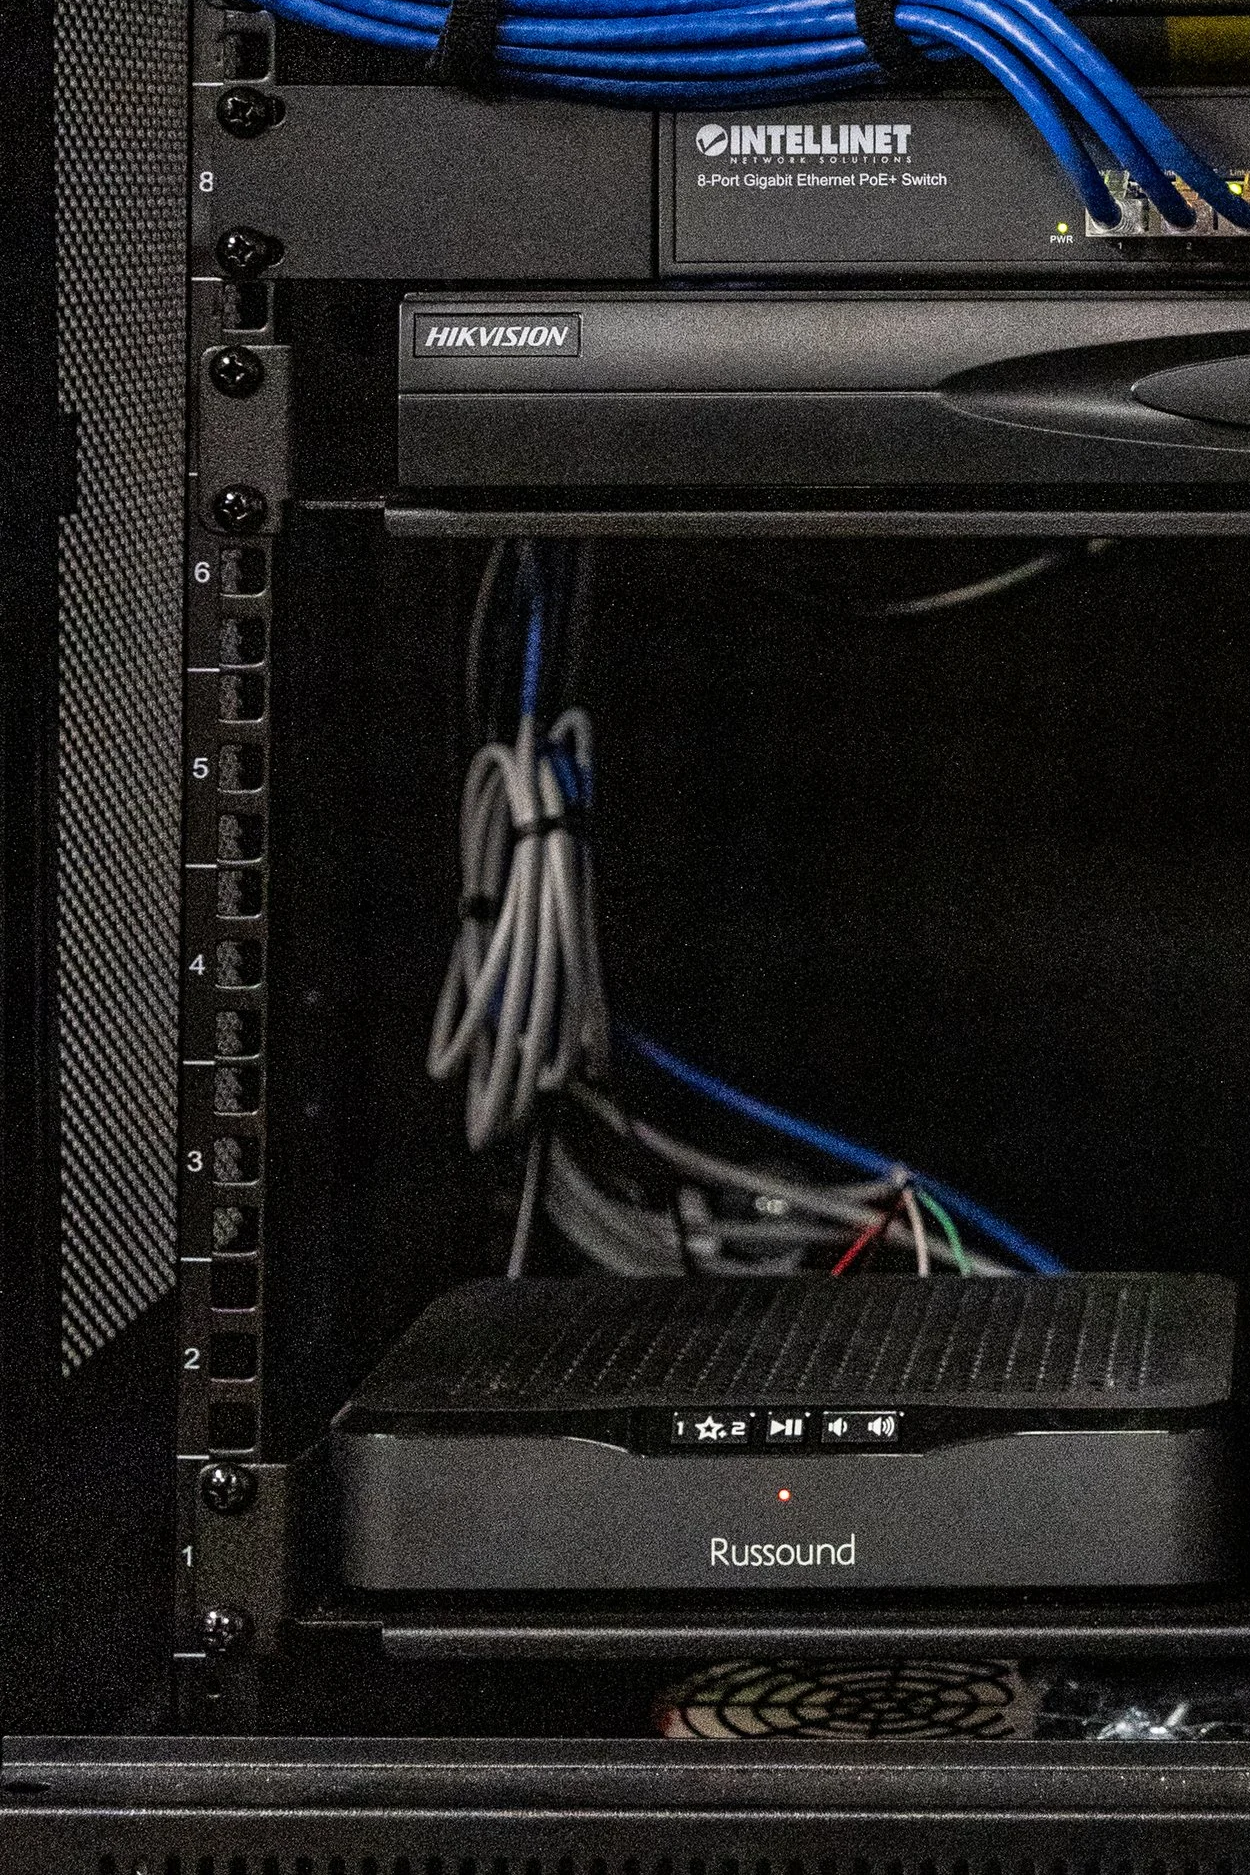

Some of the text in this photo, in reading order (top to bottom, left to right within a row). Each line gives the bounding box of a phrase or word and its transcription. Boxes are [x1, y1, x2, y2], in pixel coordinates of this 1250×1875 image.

[730, 125, 912, 155] INTELLINET
[198, 170, 214, 193] 8
[697, 172, 948, 189] 8-Port Gigabit Ethernet PoE+ Switch
[1050, 235, 1073, 243] PWR
[1185, 241, 1193, 251] 2
[425, 326, 568, 346] HIKVISION
[194, 561, 211, 584] 6
[192, 757, 209, 779] 5
[188, 953, 206, 976] 4
[187, 1150, 203, 1173] 3
[183, 1347, 200, 1370] 2
[182, 1545, 192, 1567] 1
[711, 1533, 855, 1566] Russound
